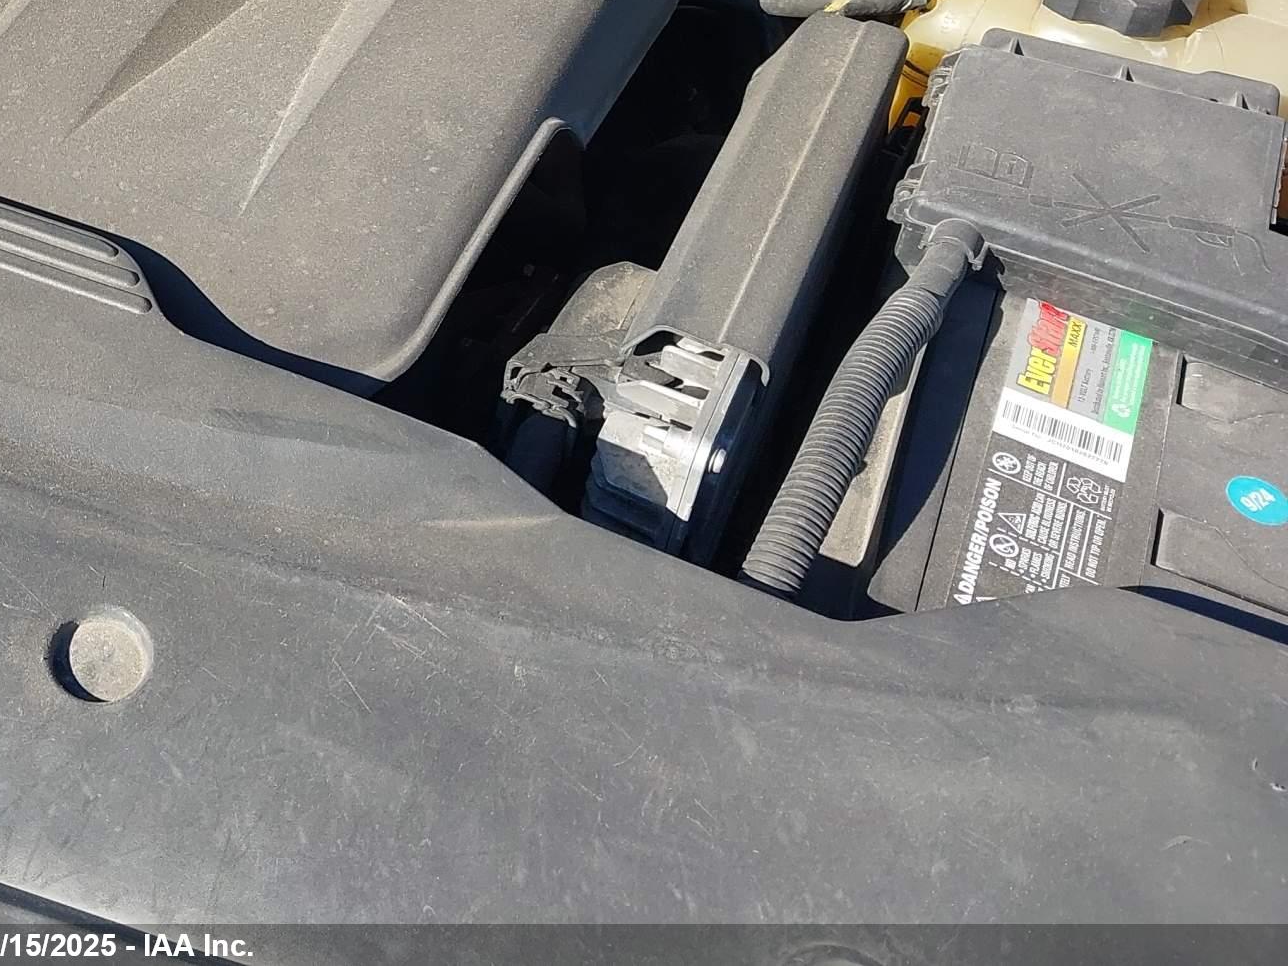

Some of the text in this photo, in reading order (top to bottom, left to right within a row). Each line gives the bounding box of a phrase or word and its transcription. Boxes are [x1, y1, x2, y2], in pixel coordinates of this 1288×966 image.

[1068, 321, 1082, 347] MAXX
[1016, 301, 1069, 395] EverStart
[1240, 488, 1276, 512] 9/24
[1025, 493, 1045, 540] SULFURIC ACID CAN
[1037, 497, 1057, 545] CAUSE BLINDNESS
[958, 477, 1002, 594] DANGER/POISON
[1050, 519, 1064, 541] SEVERE
[1092, 534, 1103, 546] OR
[1048, 537, 1059, 550] OR
[1090, 543, 1101, 556] TIP
[1018, 547, 1032, 570] SPARKS
[1029, 551, 1043, 575] FLAMES
[1040, 552, 1055, 580] SMOKING
[1064, 553, 1077, 570] READ
[1087, 556, 1099, 572] NOT
[1085, 569, 1096, 579] DO
